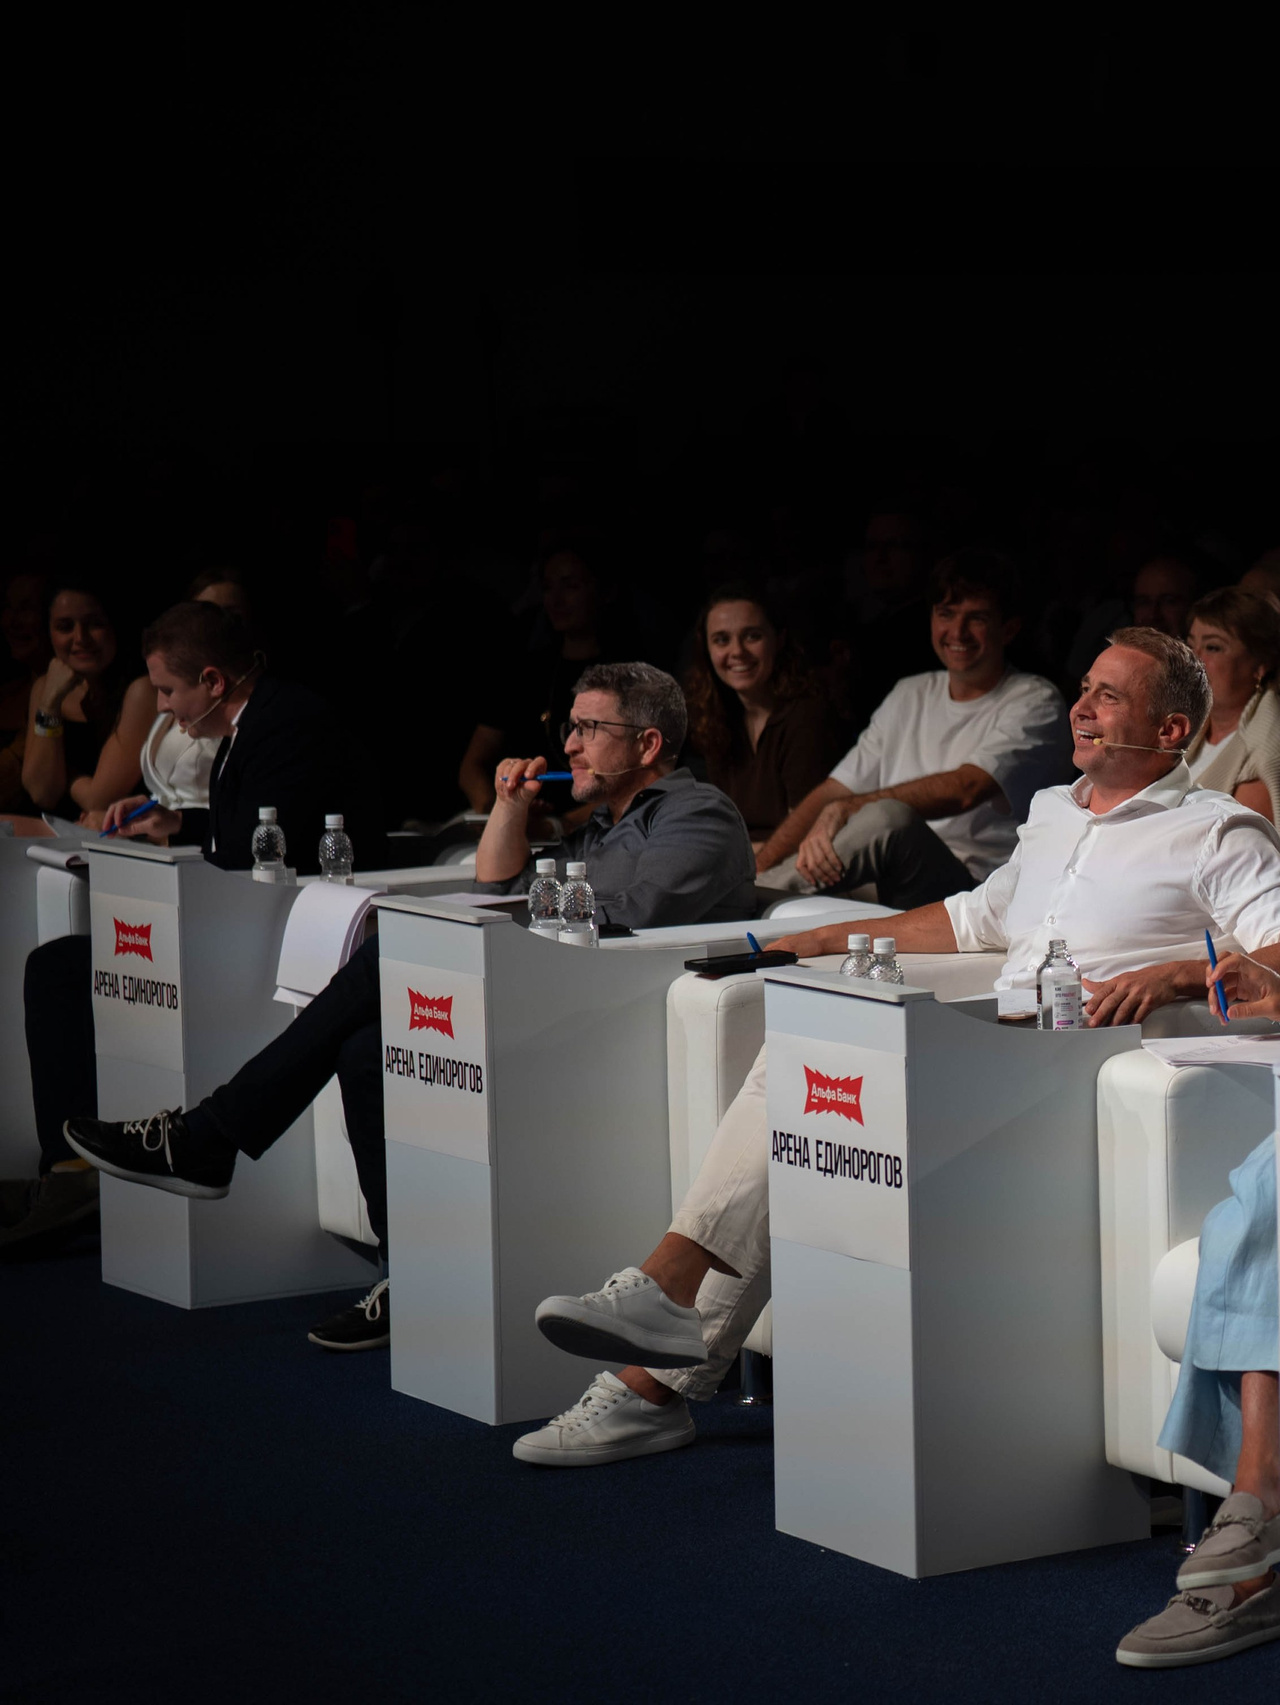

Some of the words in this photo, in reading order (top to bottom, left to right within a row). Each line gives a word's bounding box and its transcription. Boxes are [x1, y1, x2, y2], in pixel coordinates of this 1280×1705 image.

[118, 931, 135, 946] Альфа
[135, 933, 149, 947] Банк
[94, 970, 120, 999] АРЕНА
[123, 975, 178, 1010] ЕДИНОРОГОВ
[413, 1003, 433, 1020] Альфа
[433, 1006, 449, 1022] Банк
[385, 1045, 415, 1079] АРЕНА
[418, 1052, 483, 1094] ЕДИНОРОГОВ
[811, 1083, 836, 1103] Альфа
[837, 1088, 857, 1105] Банк
[772, 1130, 811, 1169] АРЕНА
[815, 1139, 903, 1189] ЕДИНОРОГОВ
